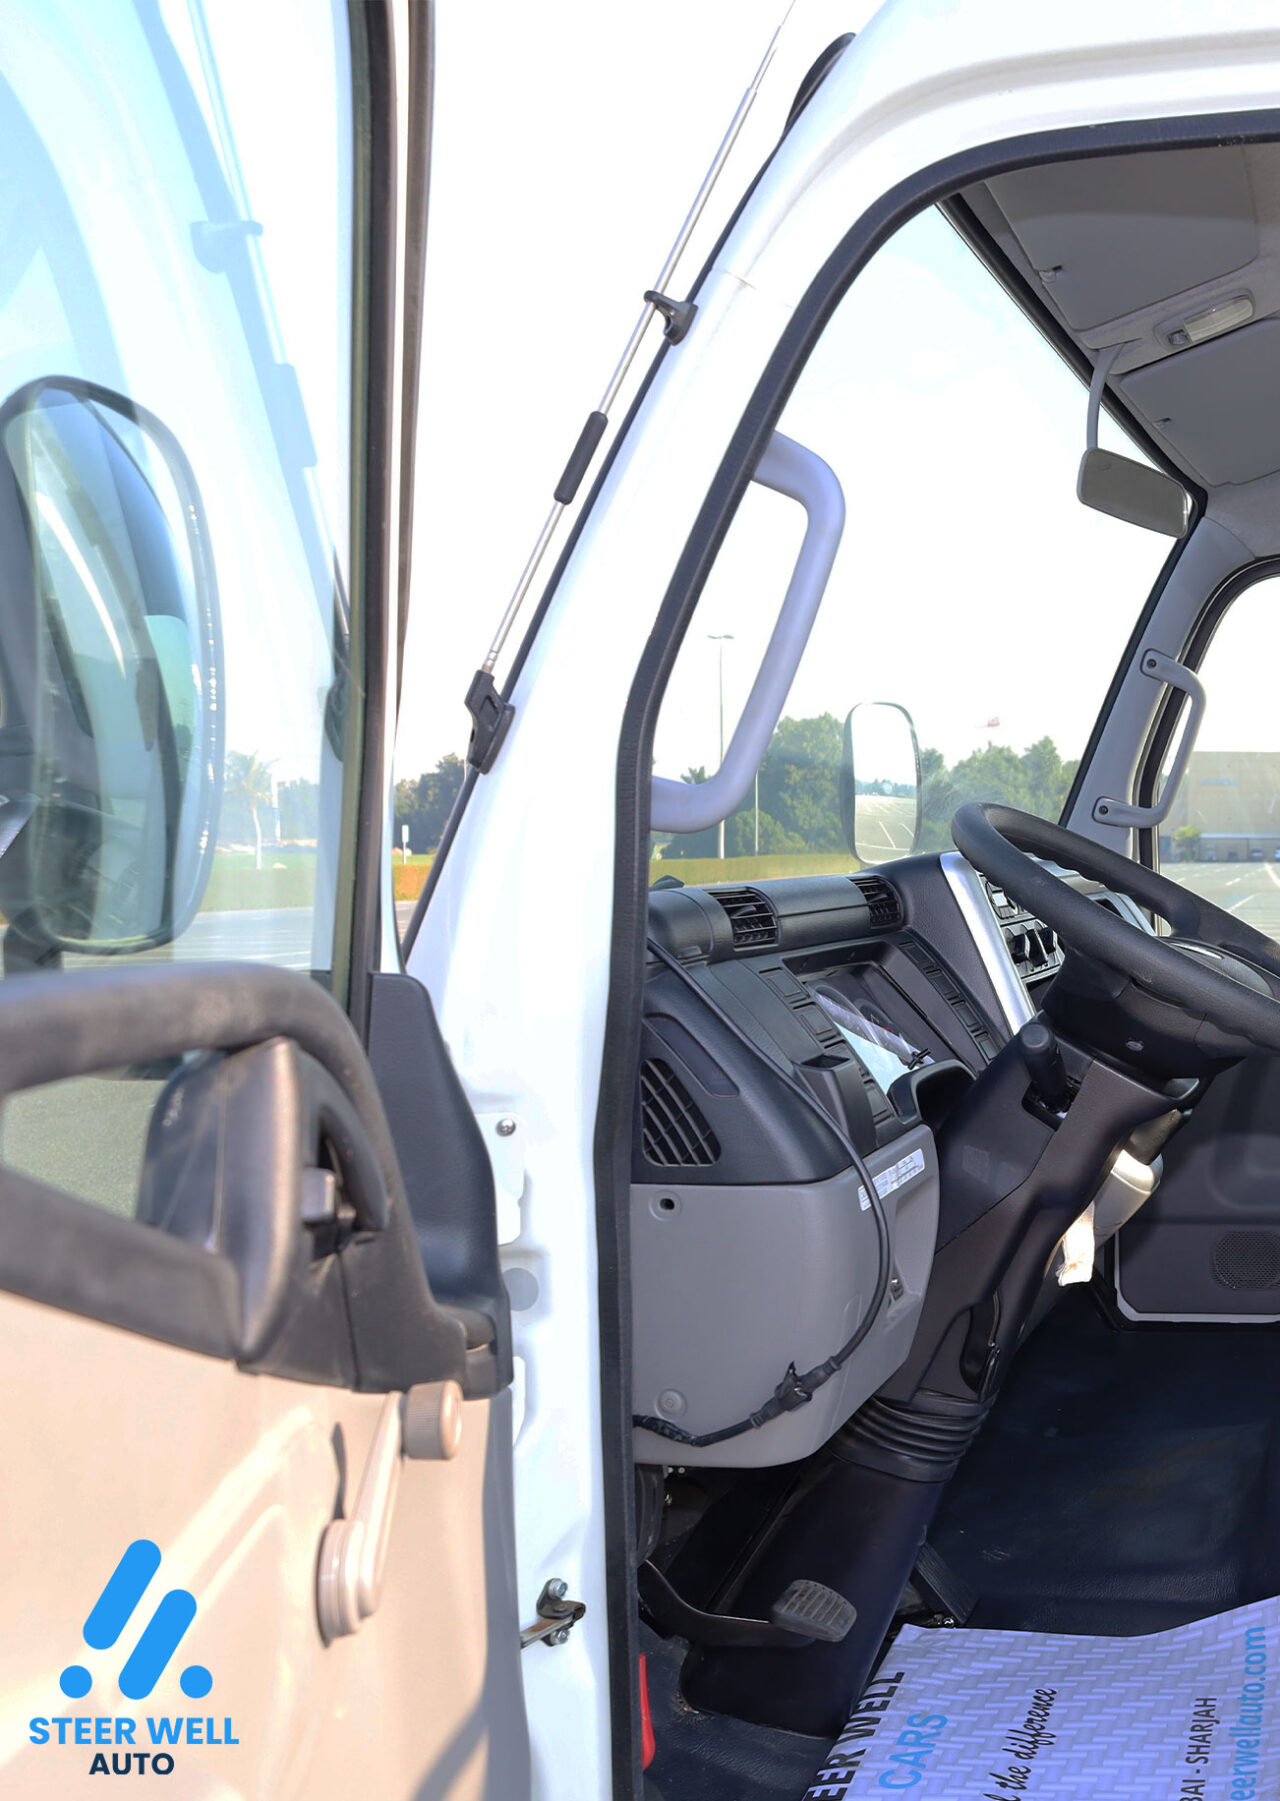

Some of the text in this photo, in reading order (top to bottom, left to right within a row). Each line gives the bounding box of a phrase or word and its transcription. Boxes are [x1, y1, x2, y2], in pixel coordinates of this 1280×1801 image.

[837, 1672, 905, 1744] WELL
[1002, 1688, 1057, 1760] difference
[1185, 1698, 1220, 1764] SHARJAH
[879, 1713, 948, 1789] CARS
[989, 1765, 1031, 1790] the
